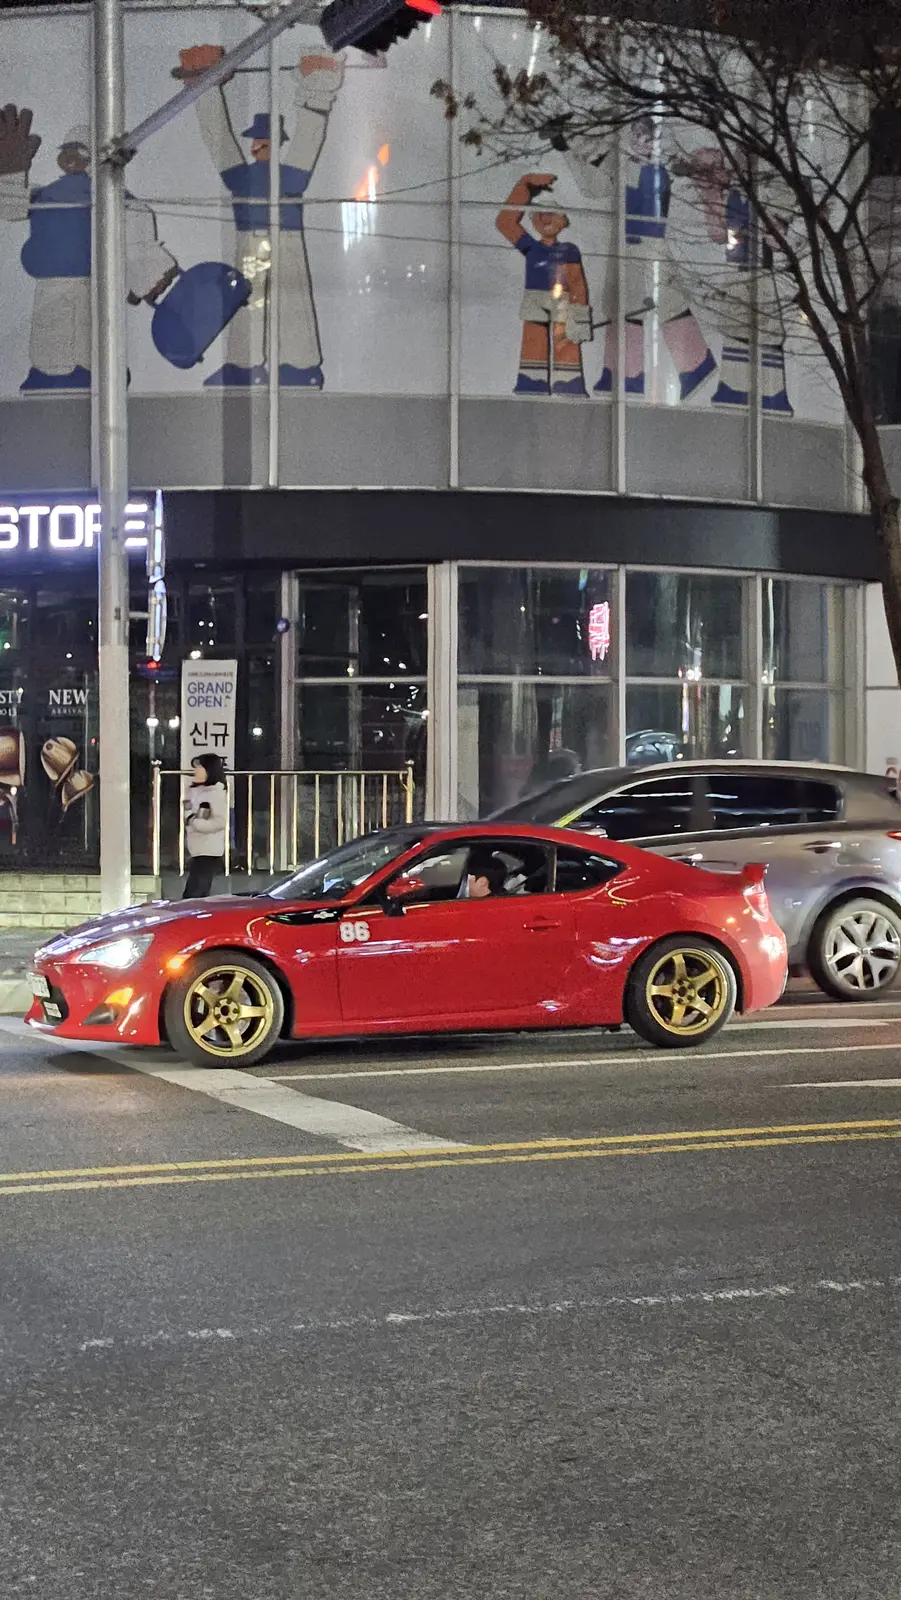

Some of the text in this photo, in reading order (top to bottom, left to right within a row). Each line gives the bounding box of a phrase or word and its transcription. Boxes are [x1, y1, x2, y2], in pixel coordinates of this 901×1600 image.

[187, 681, 233, 695] GRAND
[49, 689, 90, 705] NEW
[187, 695, 222, 708] OPEN
[190, 721, 230, 747] 신규
[340, 921, 371, 943] 86
